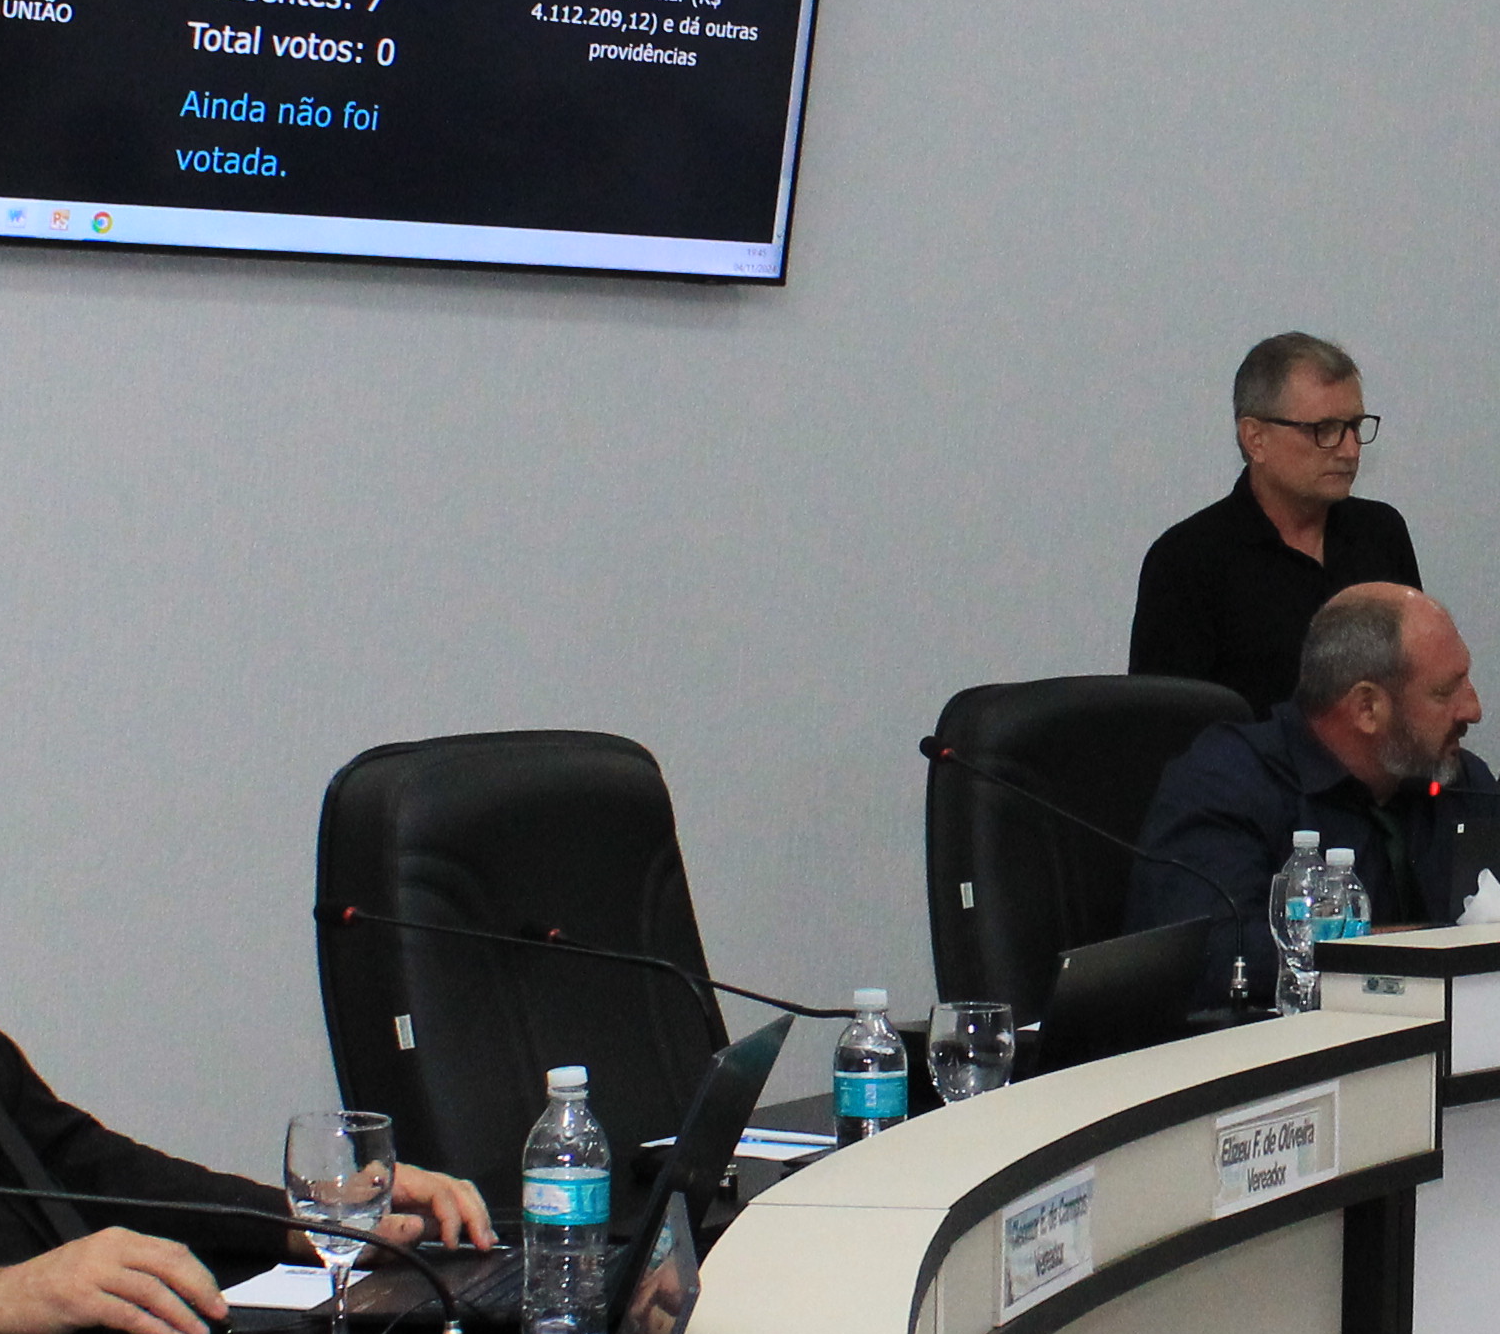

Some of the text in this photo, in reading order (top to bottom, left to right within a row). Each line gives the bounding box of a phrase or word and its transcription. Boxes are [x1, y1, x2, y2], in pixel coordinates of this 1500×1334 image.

[530, 2, 758, 41] 4.112.209,12) e dá outras
[186, 20, 395, 66] Total votos: 0
[587, 38, 697, 67] providências
[179, 89, 379, 131] Ainda não foi
[175, 145, 287, 177] votada.
[1253, 1129, 1261, 1159] F.
[1263, 1127, 1276, 1156] de
[1278, 1118, 1315, 1152] Oliveira
[1247, 1161, 1287, 1193] Vereador
